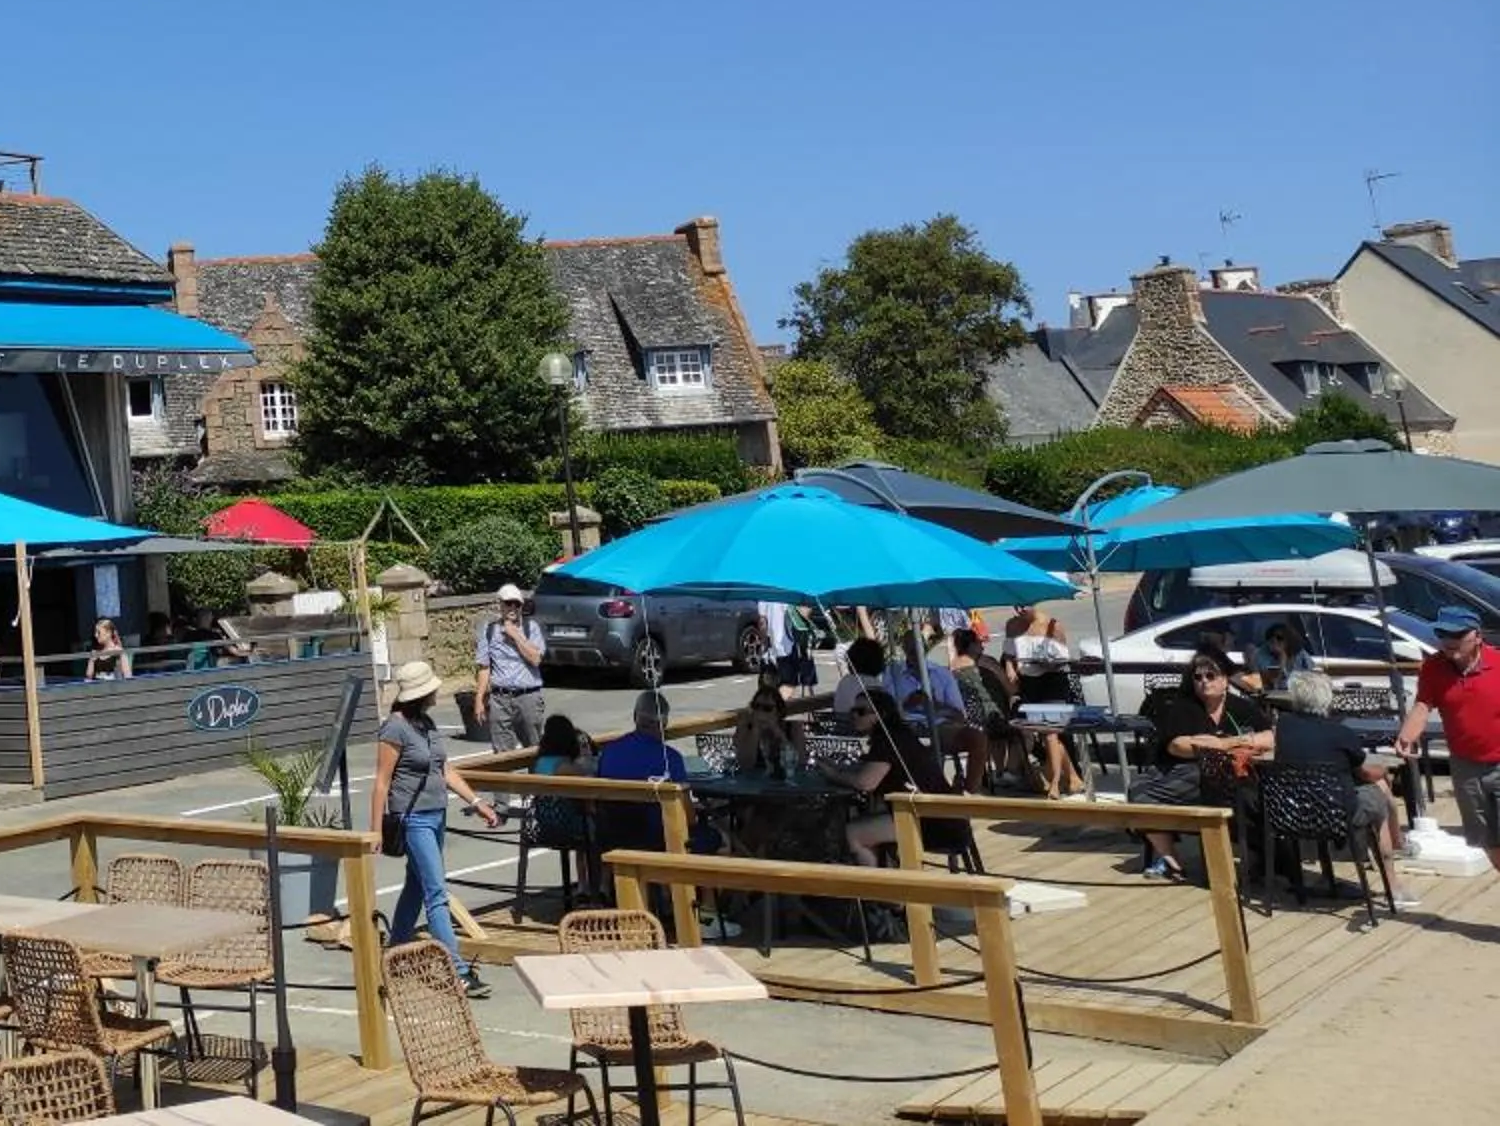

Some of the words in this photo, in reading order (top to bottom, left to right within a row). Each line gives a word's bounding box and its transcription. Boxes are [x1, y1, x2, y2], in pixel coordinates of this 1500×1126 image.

[57, 354, 89, 369] LE
[113, 354, 233, 370] DUPLEX
[207, 689, 253, 727] Duplex
